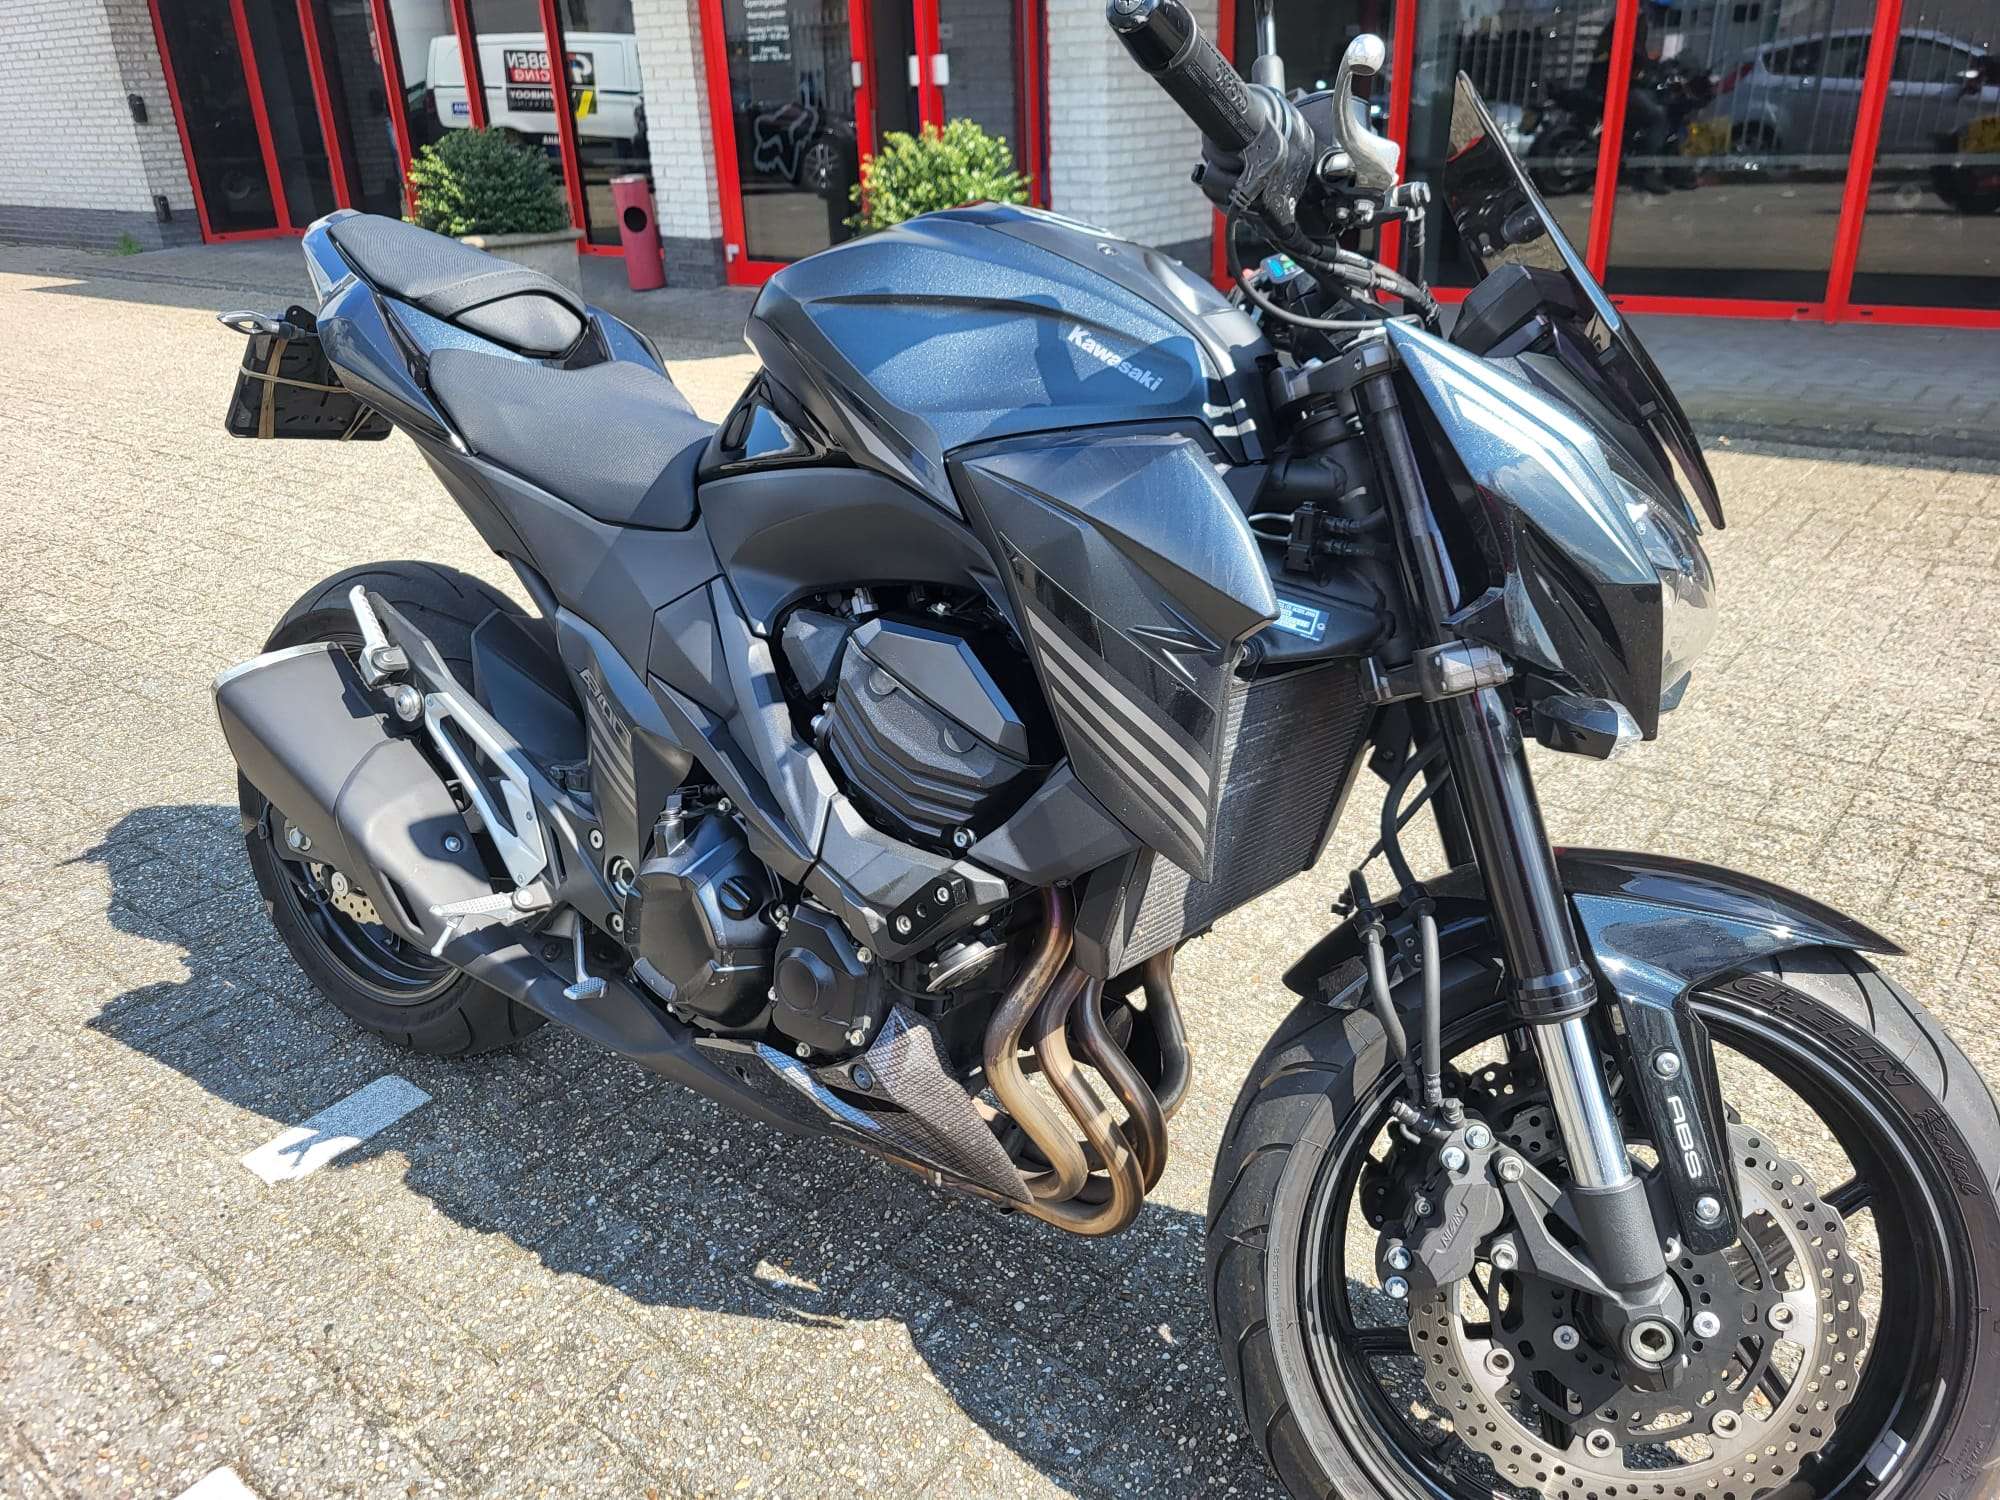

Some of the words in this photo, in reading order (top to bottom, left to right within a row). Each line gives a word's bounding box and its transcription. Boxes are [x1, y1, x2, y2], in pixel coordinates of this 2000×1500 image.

[1067, 325, 1164, 391] Kawasaki
[1732, 977, 1914, 1086] CHELIN
[1667, 1096, 1702, 1178] ABS
